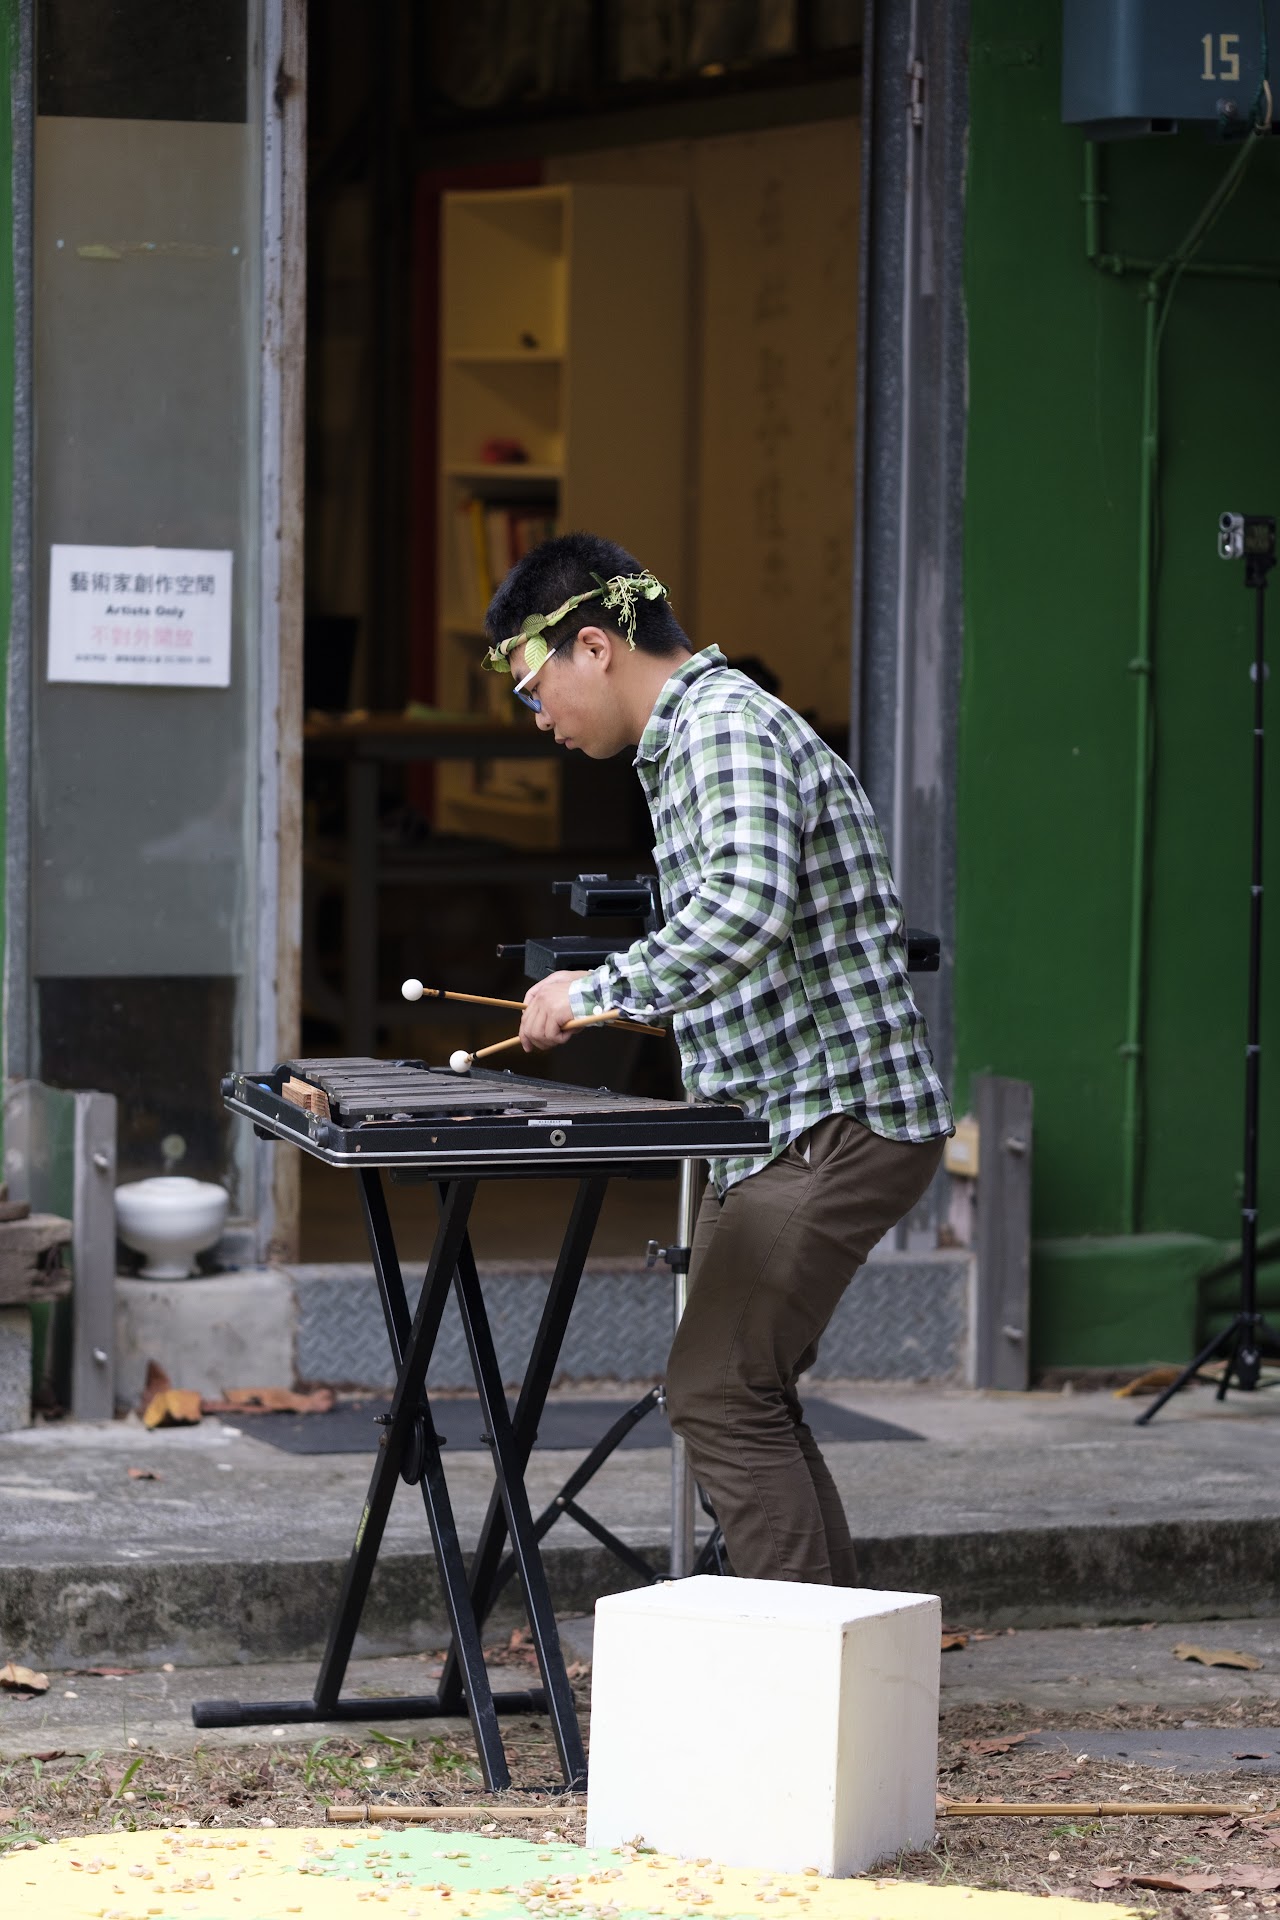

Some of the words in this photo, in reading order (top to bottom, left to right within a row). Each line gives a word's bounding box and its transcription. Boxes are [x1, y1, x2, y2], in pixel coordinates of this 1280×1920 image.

[1201, 33, 1240, 80] 15
[70, 571, 215, 596] 藝術家創作空間
[106, 605, 150, 615] Artists
[156, 606, 184, 618] Only
